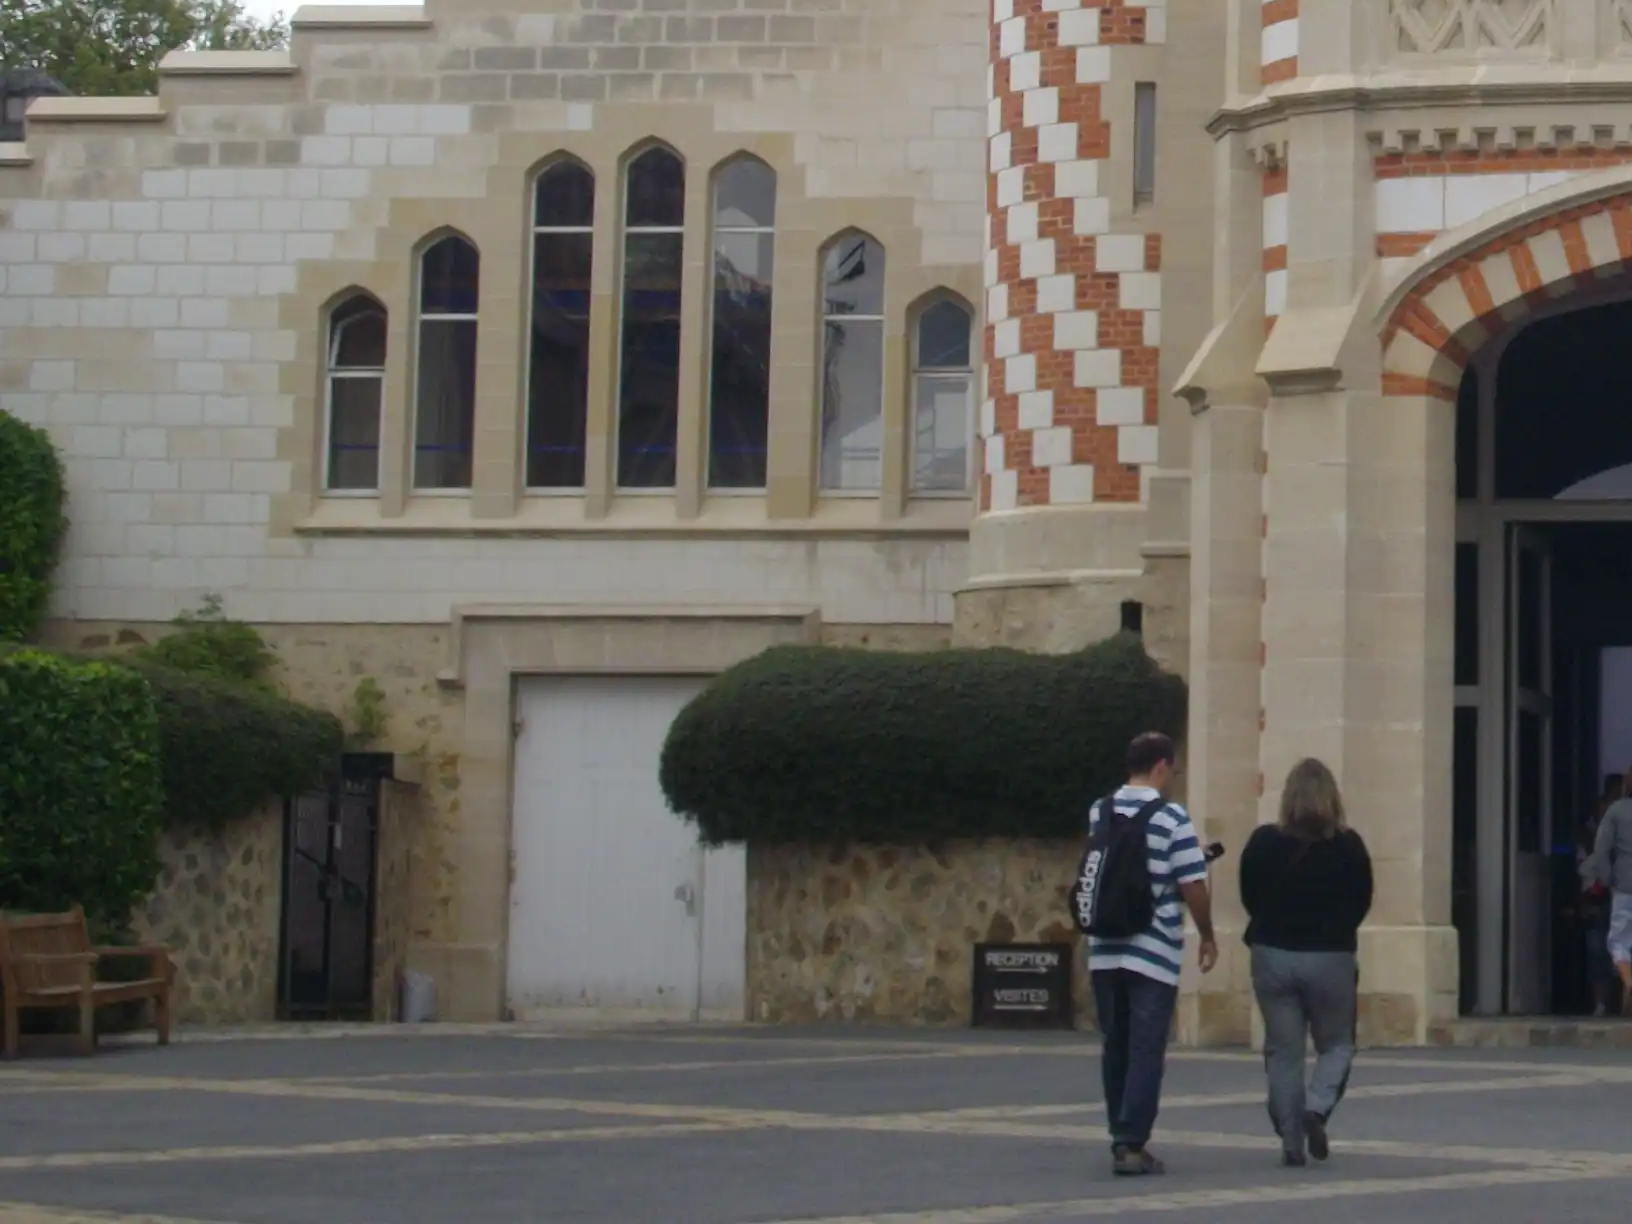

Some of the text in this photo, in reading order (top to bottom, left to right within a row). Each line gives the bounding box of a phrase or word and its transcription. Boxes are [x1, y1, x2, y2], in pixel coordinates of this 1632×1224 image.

[1076, 850, 1102, 927] adidas
[985, 952, 1059, 966] RECEPTION
[993, 988, 1049, 1002] VISITES
